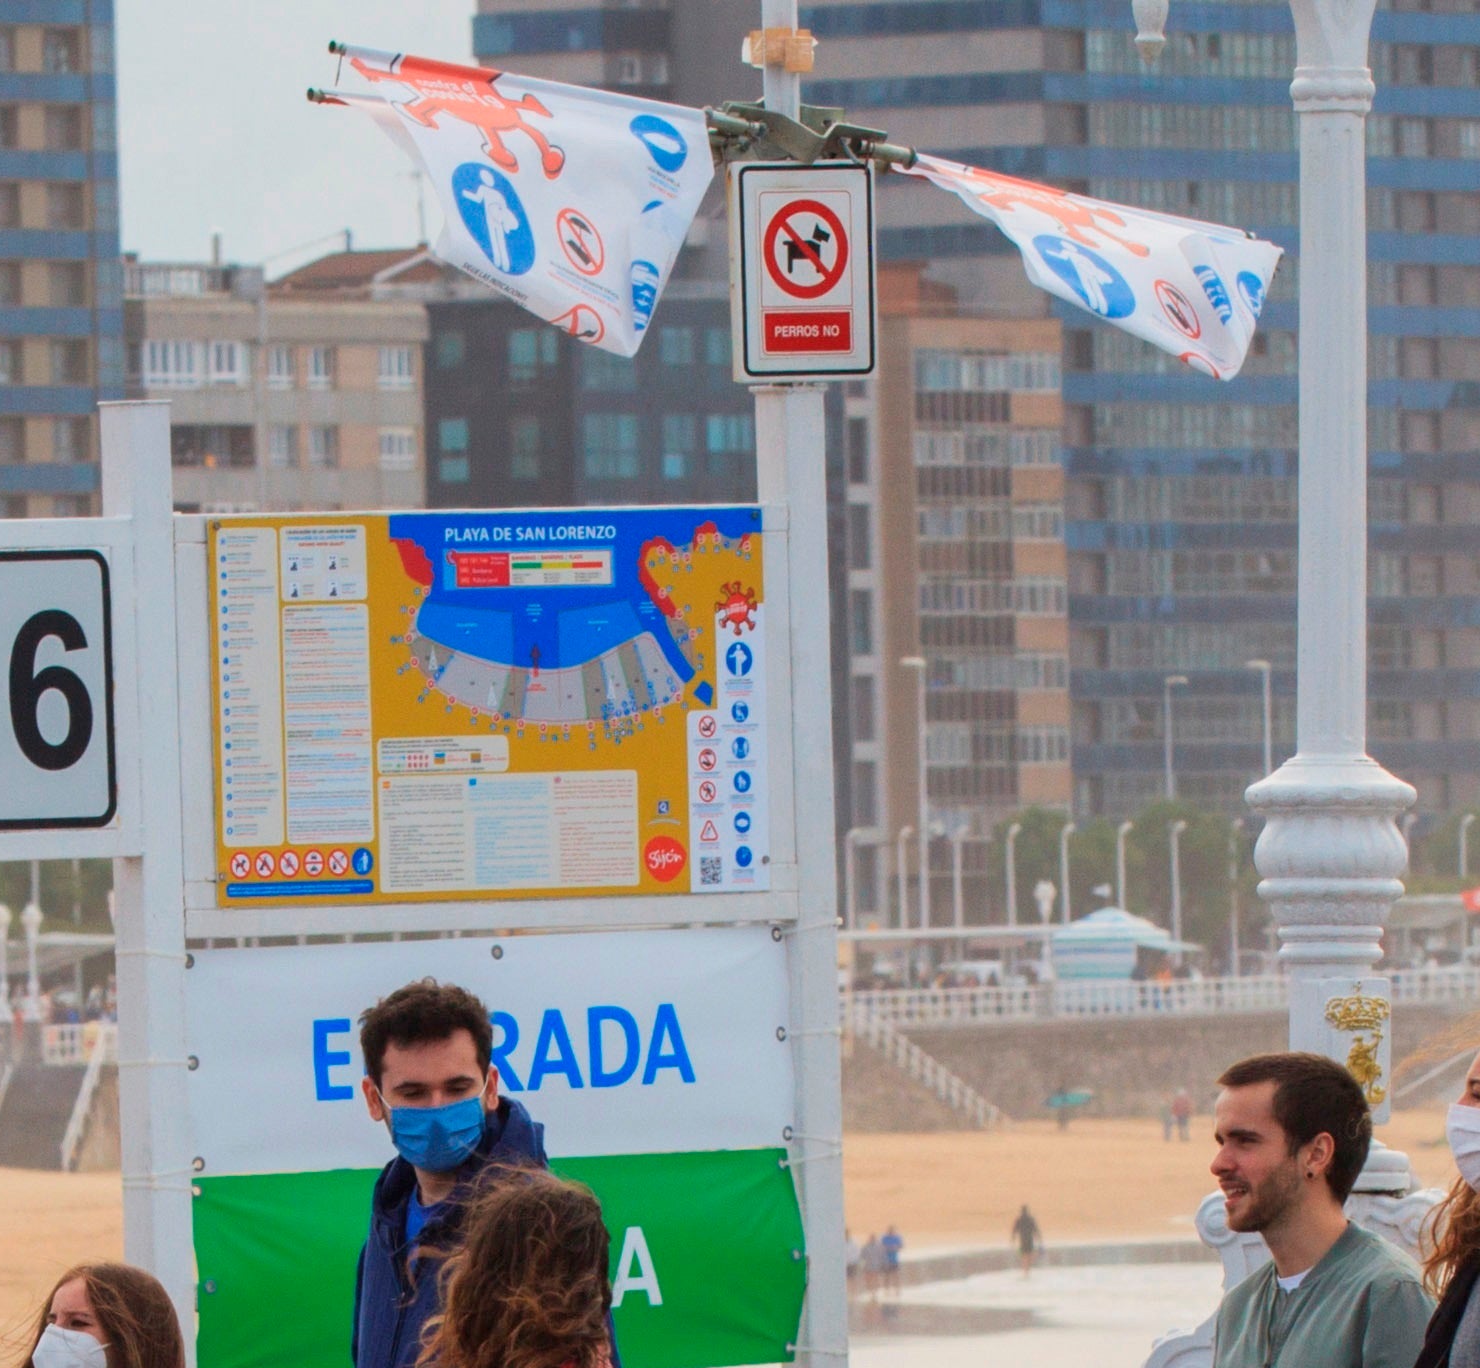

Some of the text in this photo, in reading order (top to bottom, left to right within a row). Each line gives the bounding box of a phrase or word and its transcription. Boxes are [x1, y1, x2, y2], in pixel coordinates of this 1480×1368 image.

[774, 325, 840, 338] PERROS NO
[445, 525, 617, 541] PLAYA DE SAN LORENZO
[313, 1003, 696, 1102] ERADA
